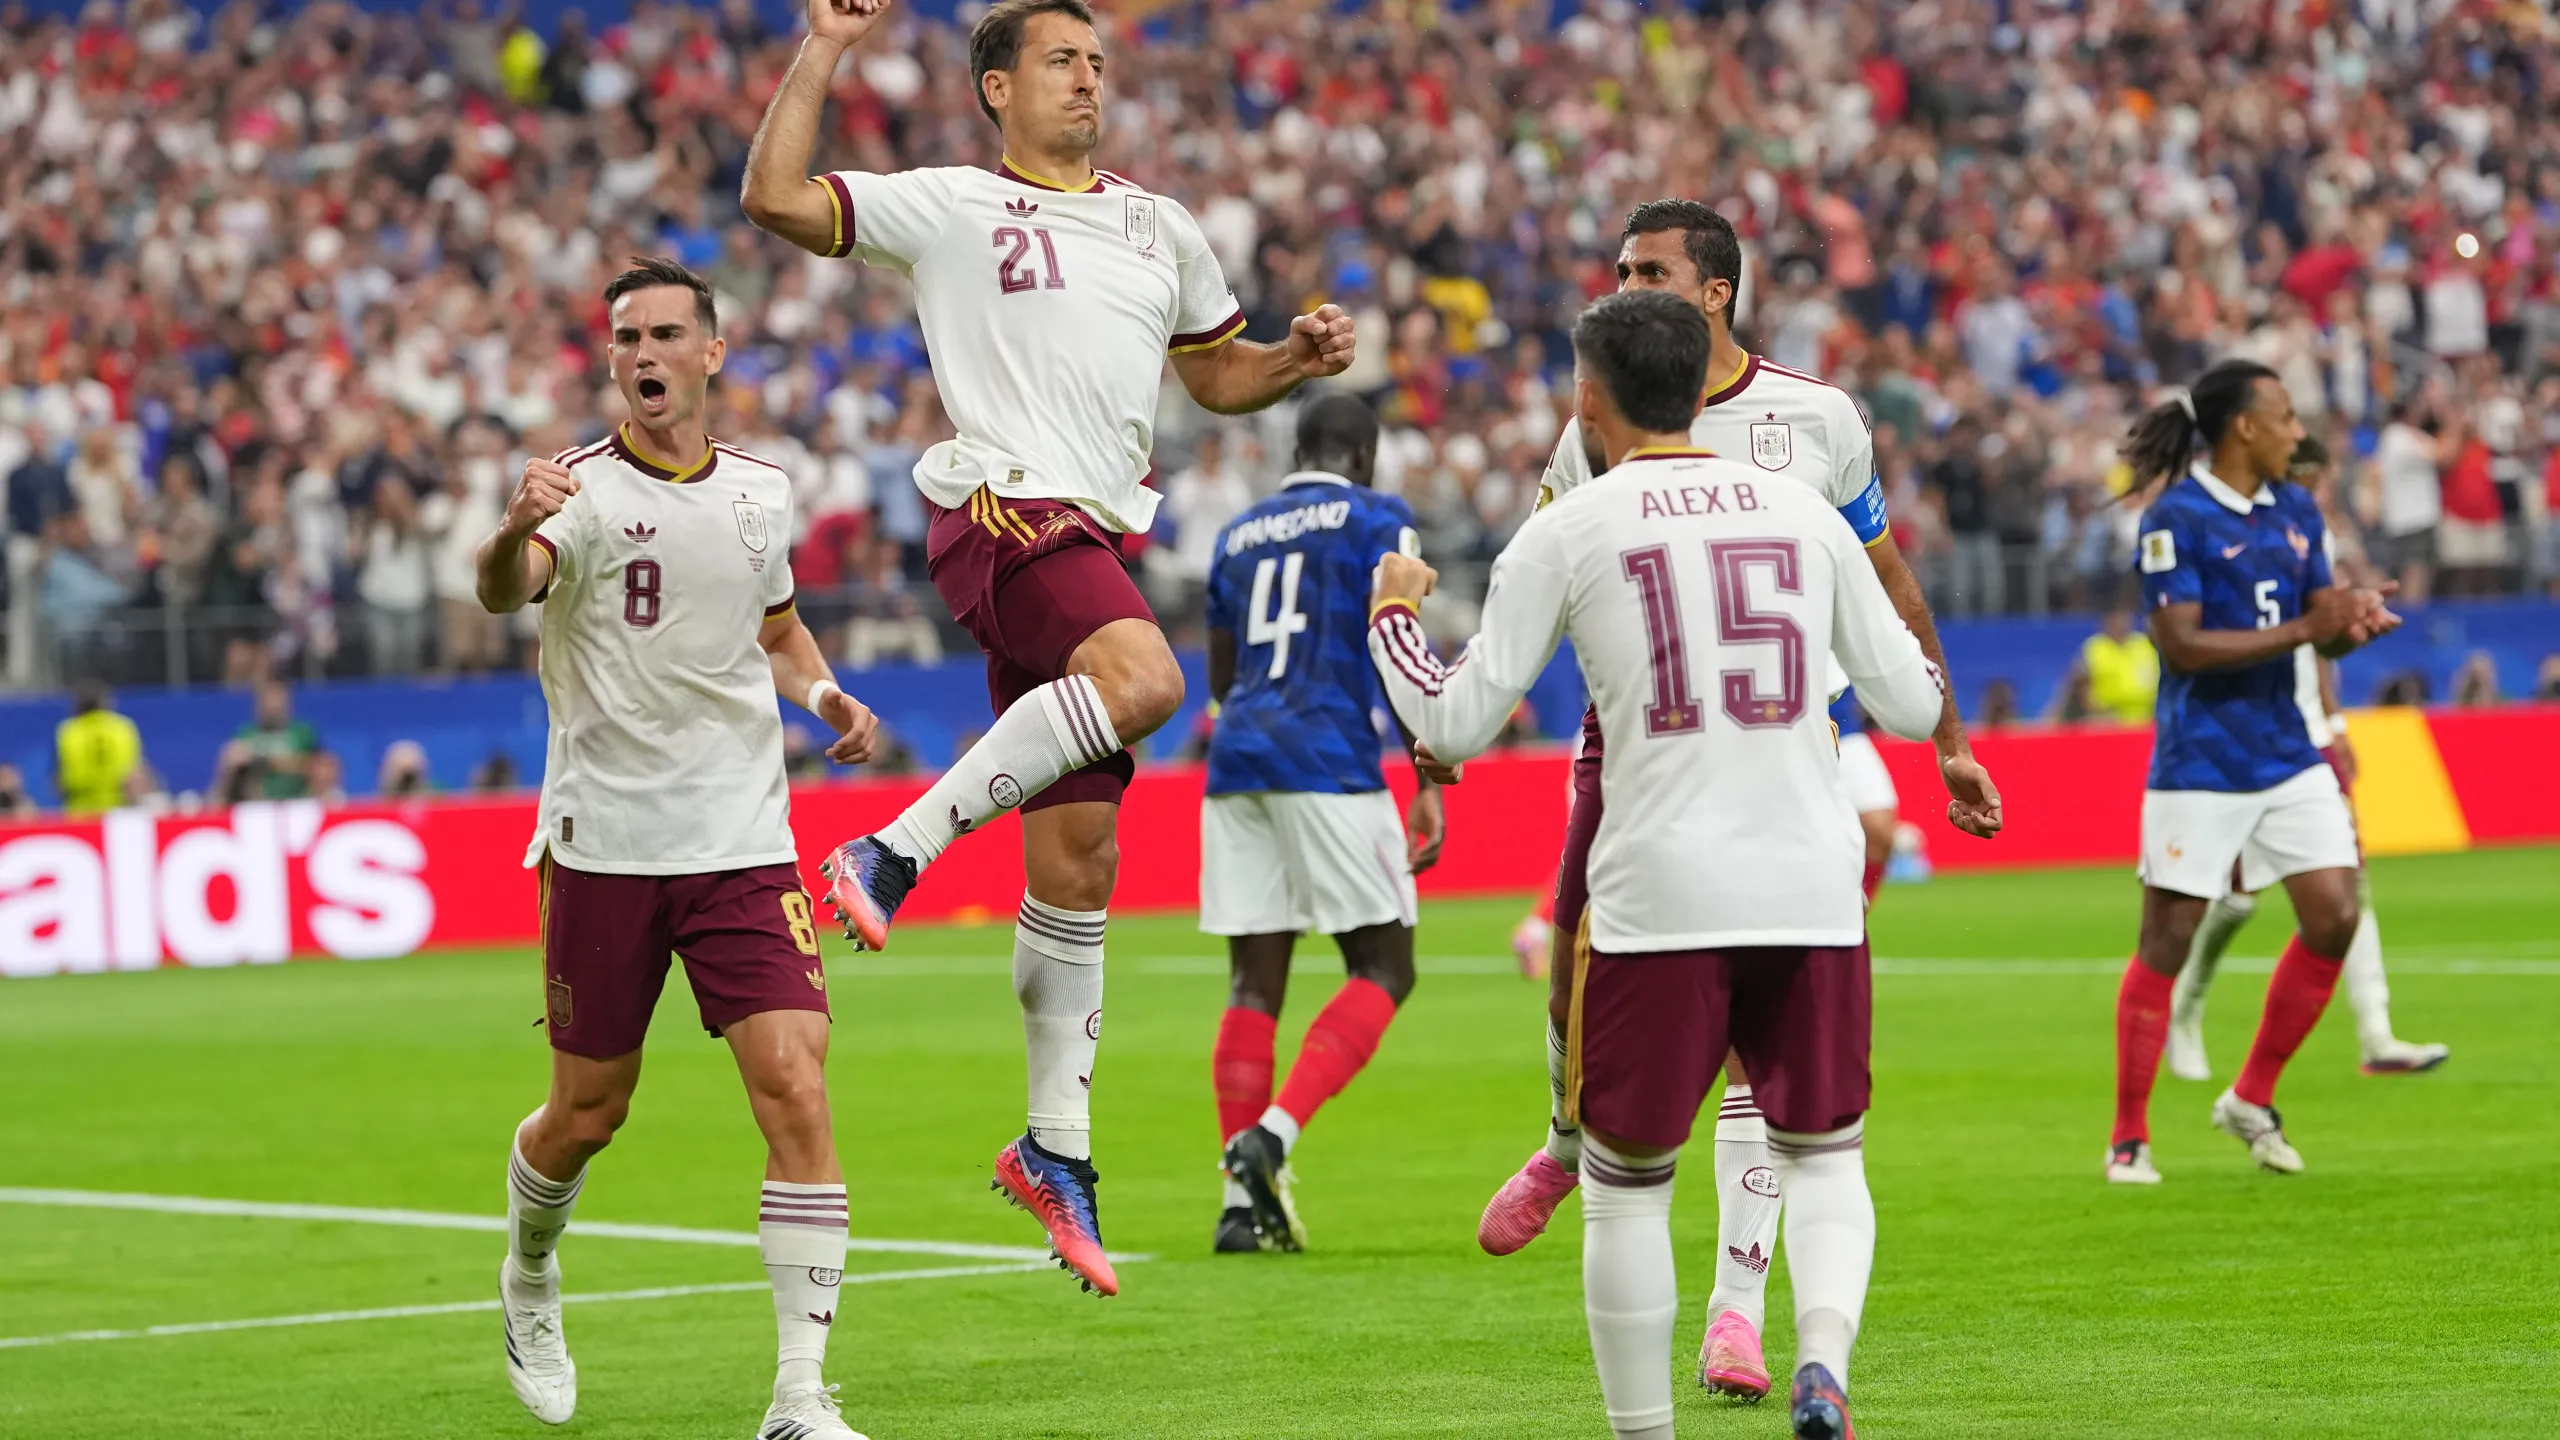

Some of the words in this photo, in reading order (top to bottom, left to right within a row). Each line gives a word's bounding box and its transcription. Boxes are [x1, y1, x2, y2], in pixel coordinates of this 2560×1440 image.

[992, 226, 1066, 295] 21
[1226, 501, 1351, 557] UPAMECANO
[1642, 485, 1727, 519] ALEX
[1733, 483, 1768, 512] B.
[623, 559, 661, 627] 8
[1247, 552, 1308, 680] 4
[2254, 579, 2280, 631] 5
[1620, 537, 1808, 739] 15
[779, 891, 818, 956] 8
